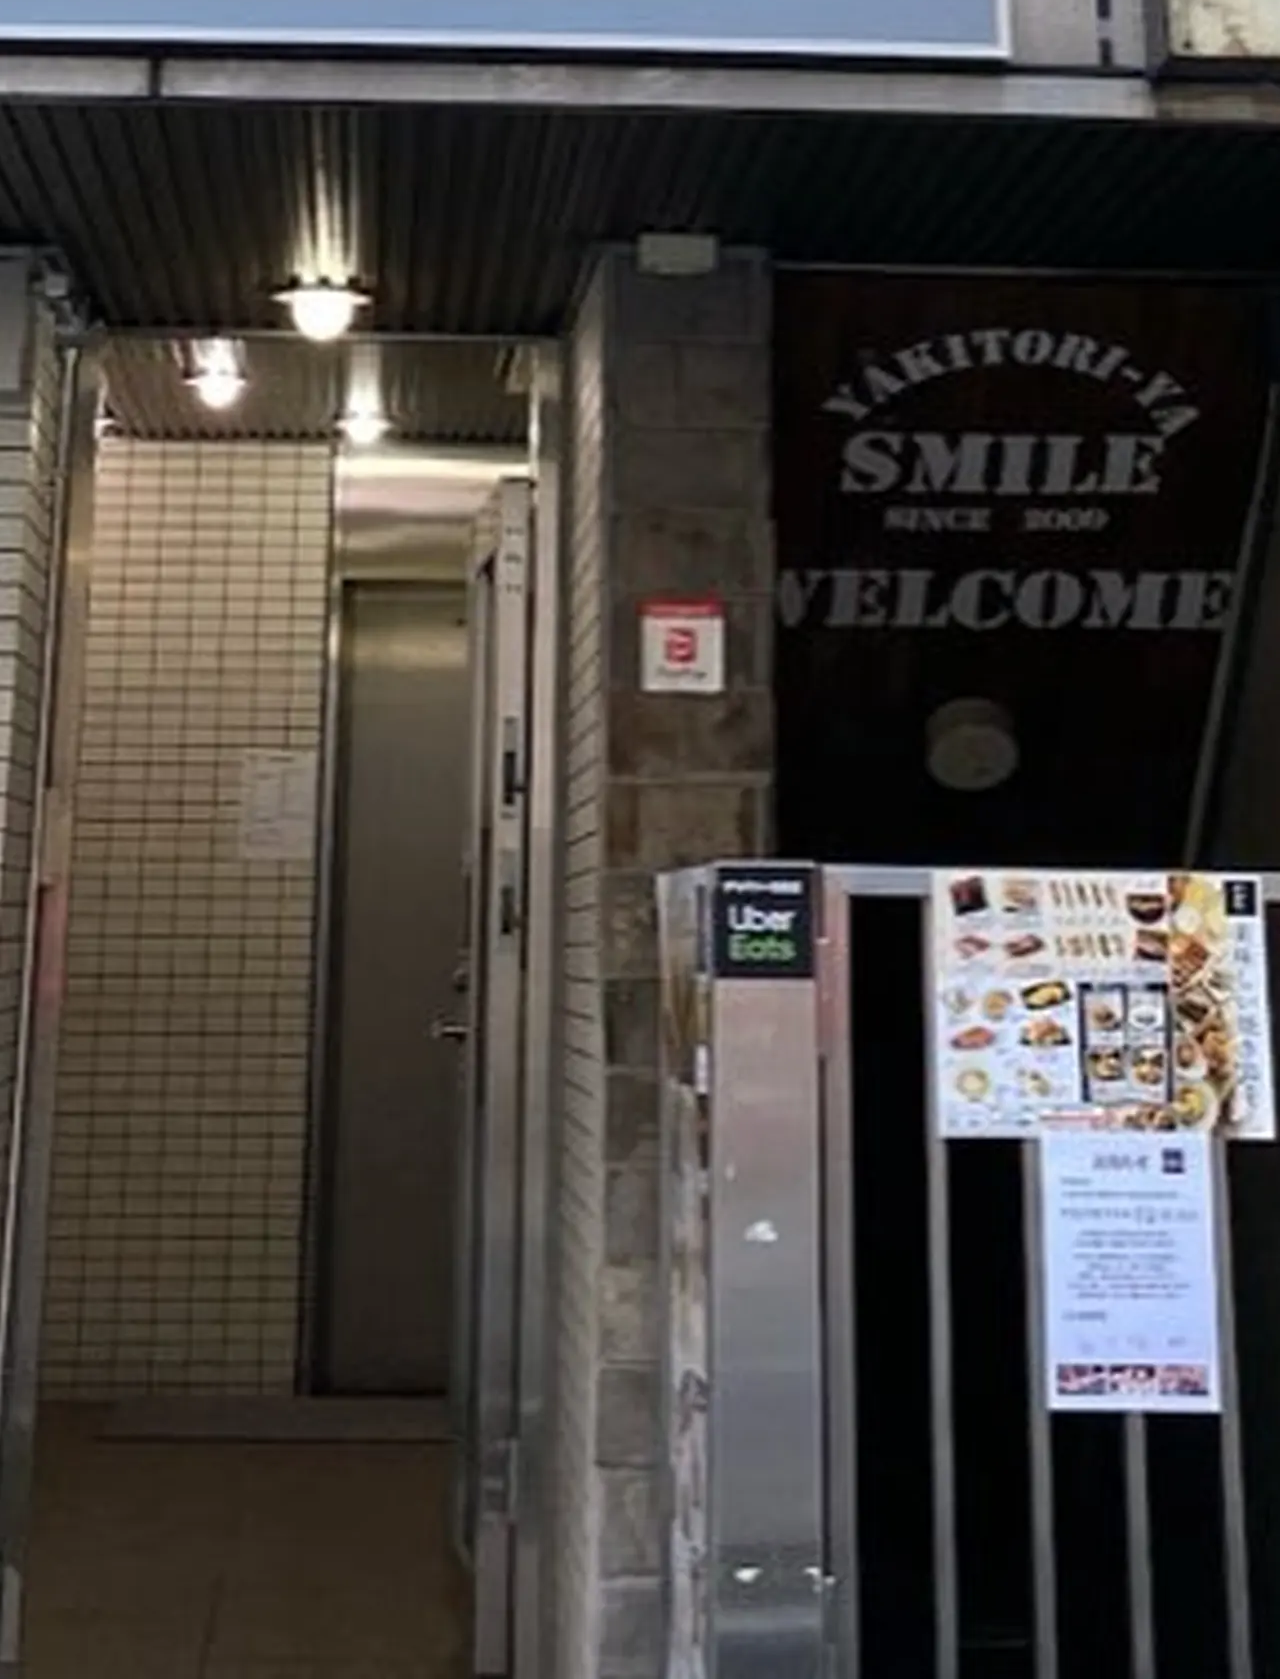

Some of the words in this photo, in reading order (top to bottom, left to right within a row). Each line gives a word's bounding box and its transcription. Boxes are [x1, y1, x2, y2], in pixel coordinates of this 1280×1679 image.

[818, 326, 1203, 439] YAKITORI-YA
[838, 429, 1164, 495] SMILE
[883, 506, 994, 533] SINCE
[727, 903, 796, 932] Uber
[728, 933, 797, 961] Eats
